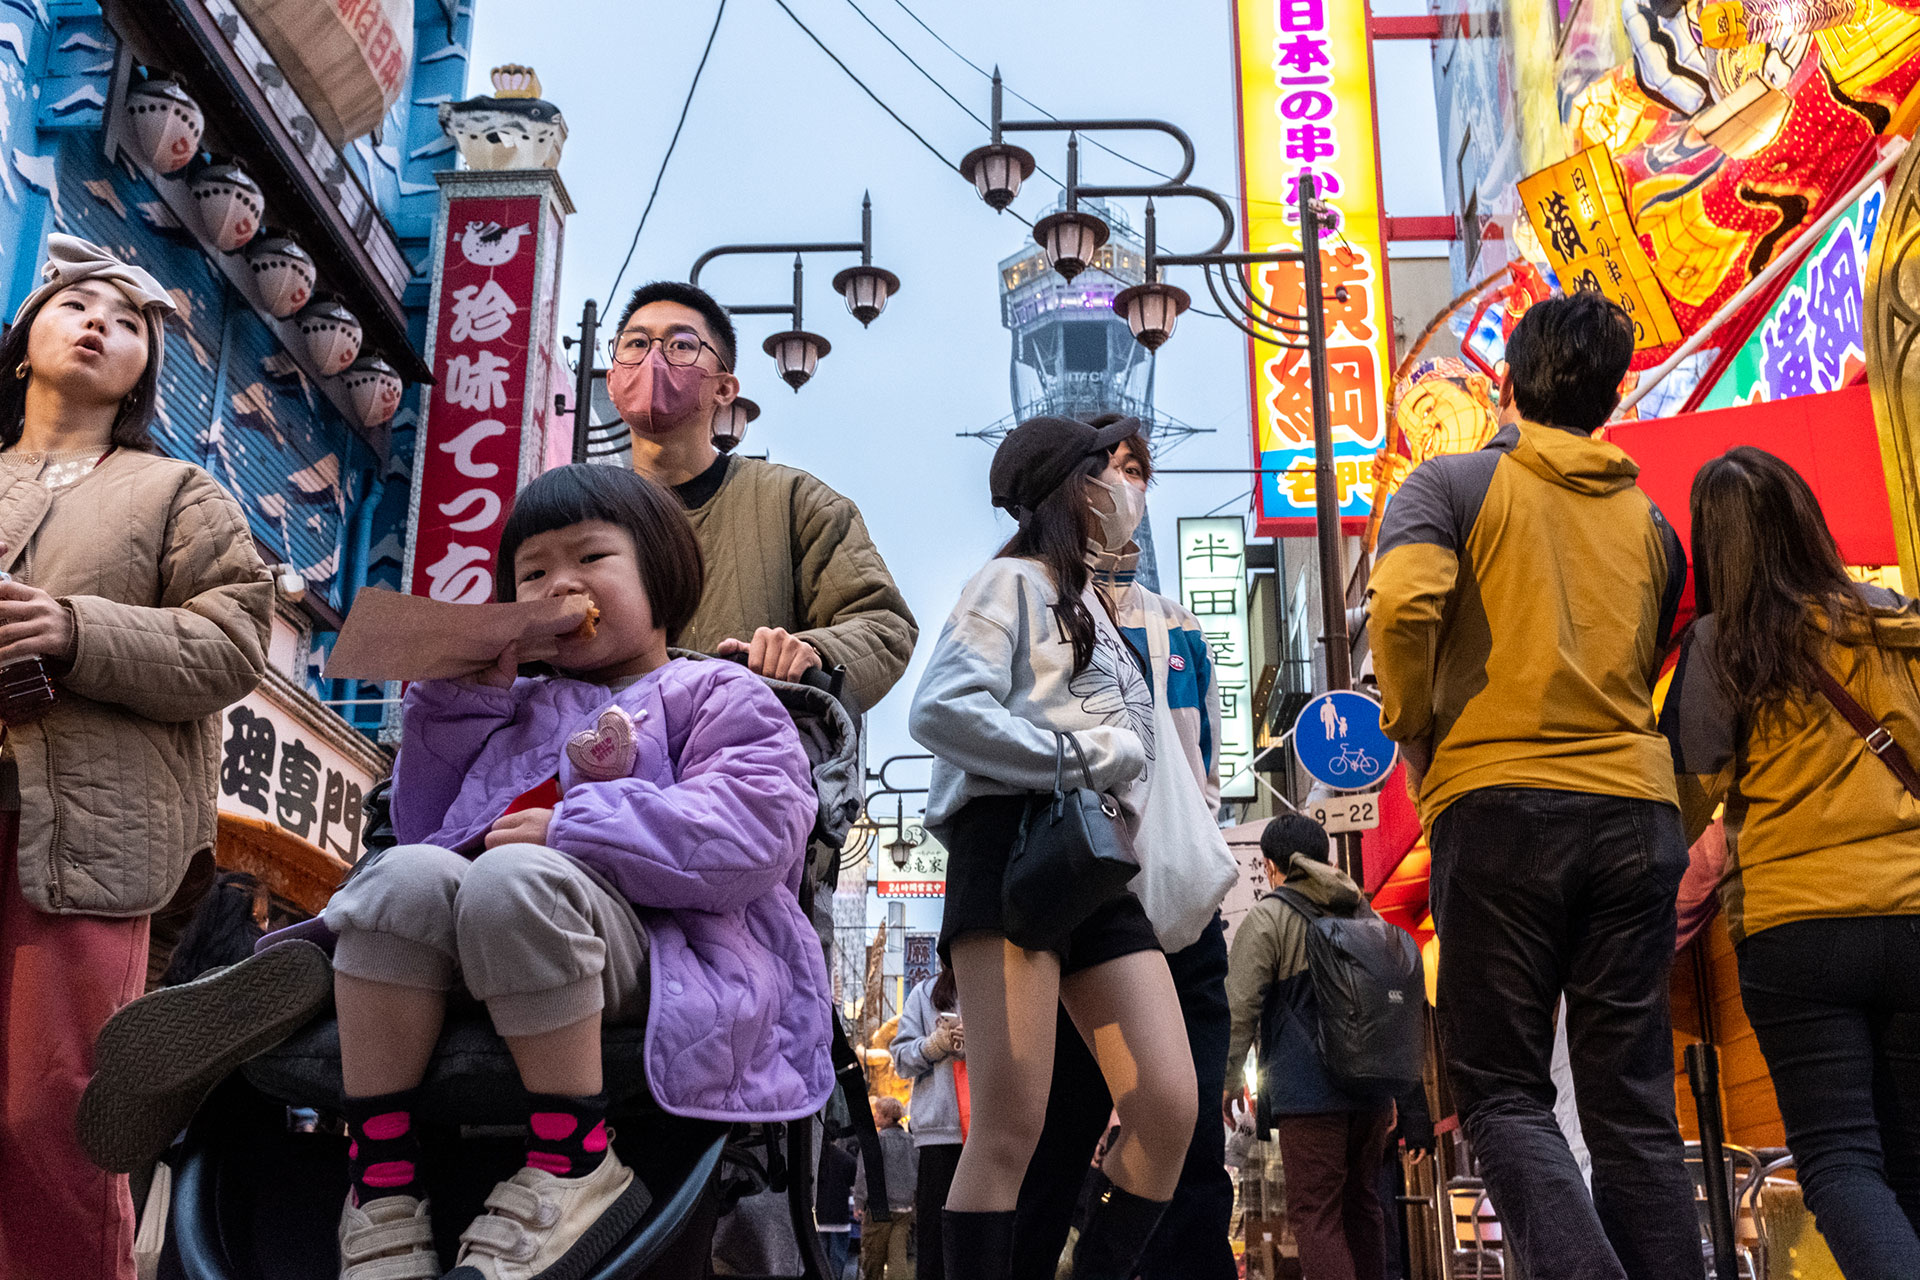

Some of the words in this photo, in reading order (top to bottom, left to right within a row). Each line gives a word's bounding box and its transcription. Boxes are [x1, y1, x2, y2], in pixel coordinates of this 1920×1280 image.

[1278, 0, 1340, 239] 日本一の串かつ
[1265, 248, 1379, 442] 横綱
[1764, 226, 1864, 401] 横綱
[220, 705, 363, 867] 理専門
